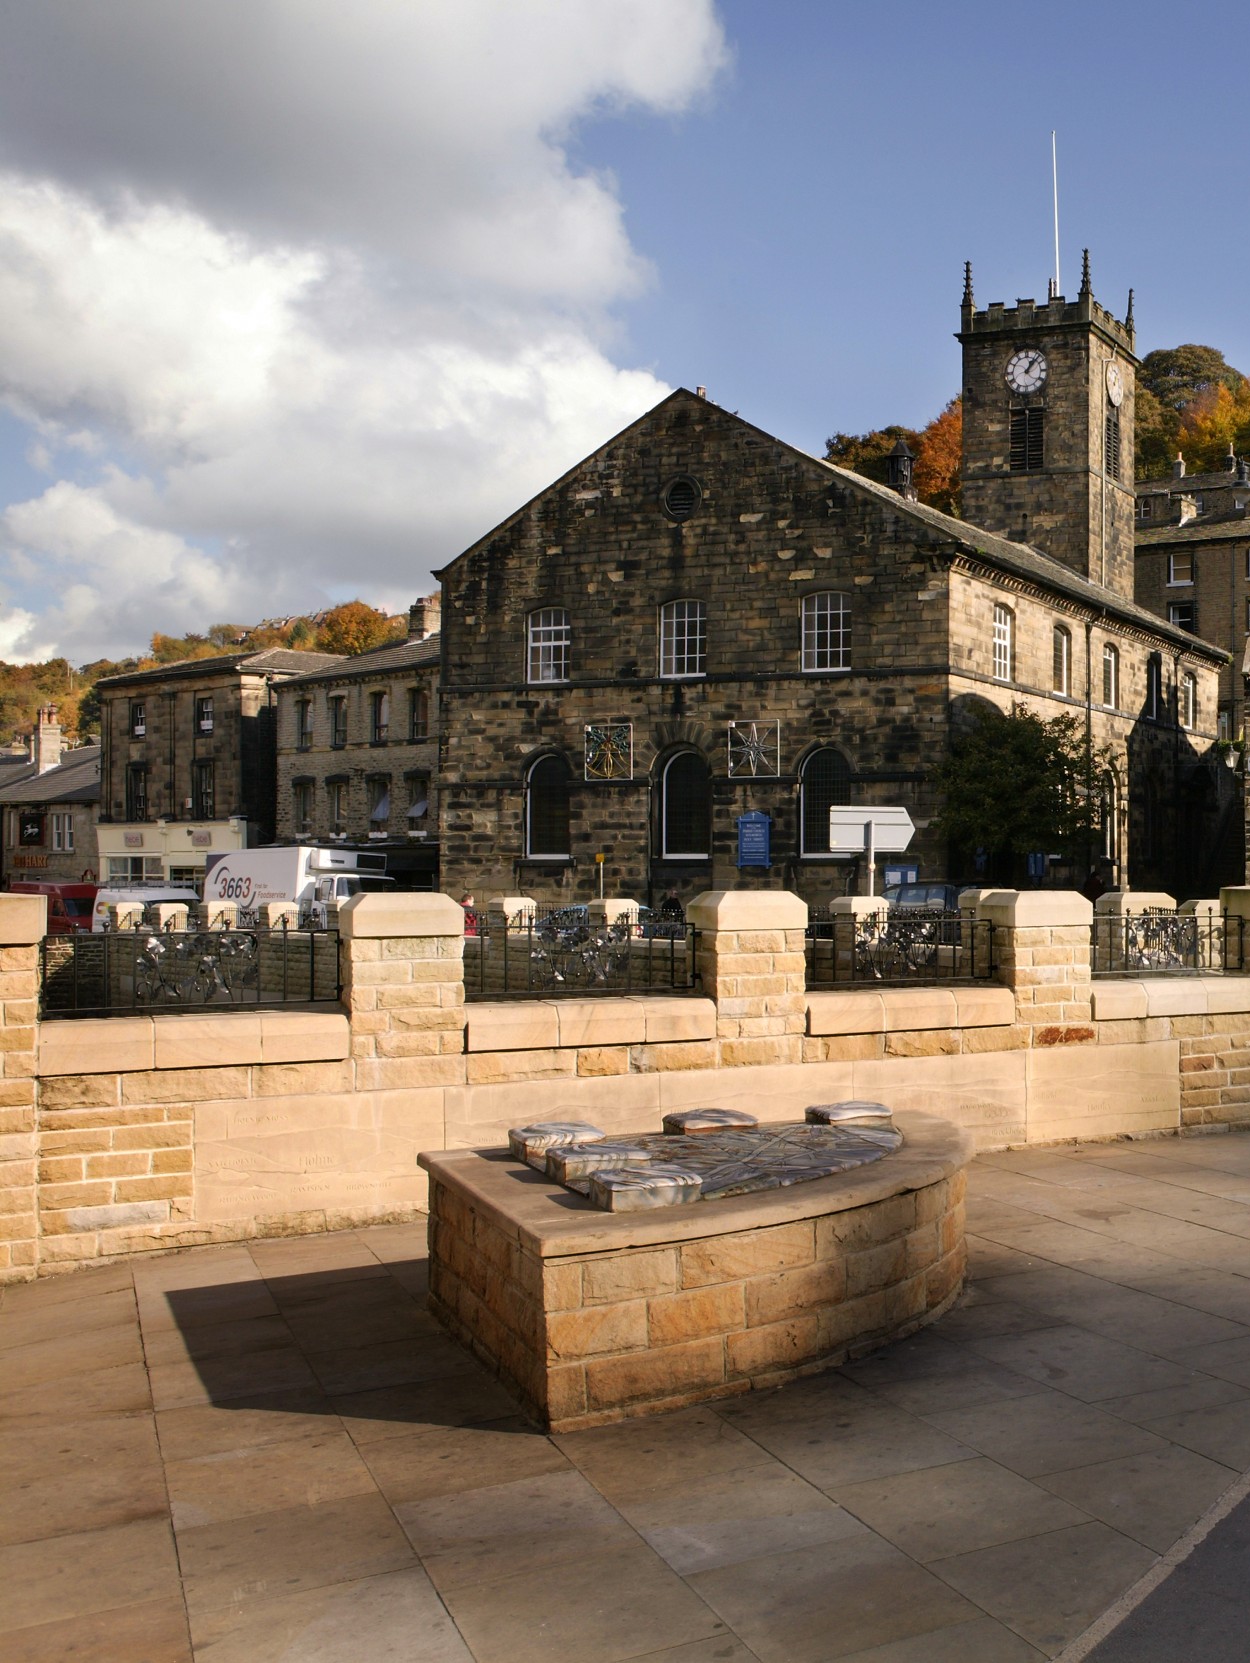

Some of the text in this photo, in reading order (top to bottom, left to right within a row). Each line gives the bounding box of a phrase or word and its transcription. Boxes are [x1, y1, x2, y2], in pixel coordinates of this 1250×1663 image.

[25, 855, 49, 867] HART
[218, 876, 252, 899] 3663
[257, 890, 287, 899] Foodservice
